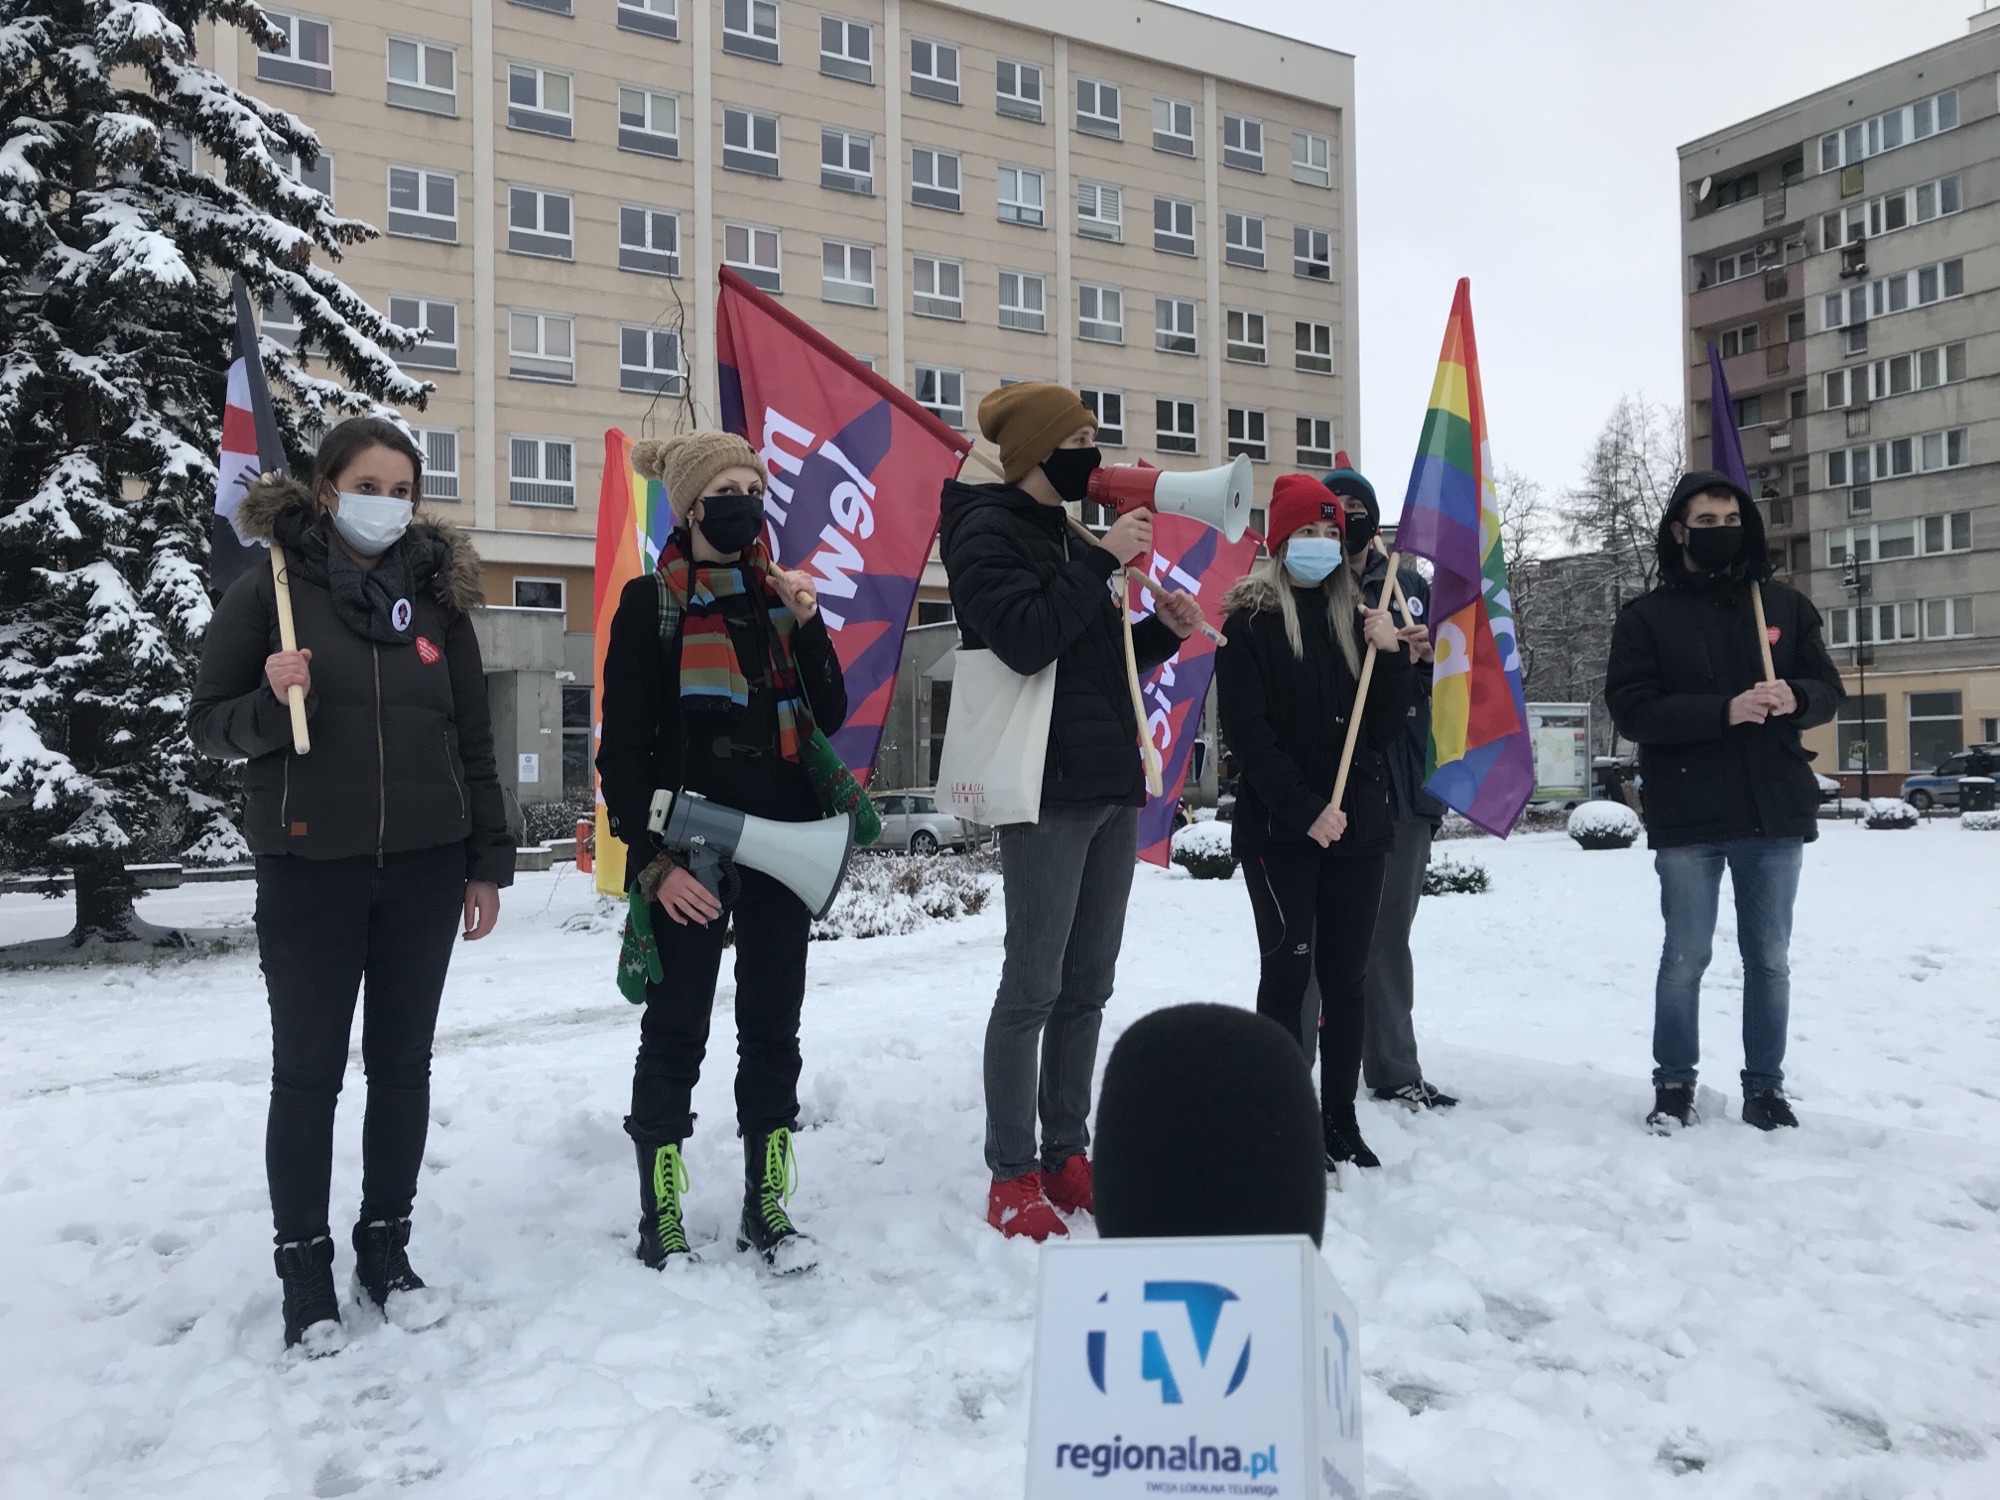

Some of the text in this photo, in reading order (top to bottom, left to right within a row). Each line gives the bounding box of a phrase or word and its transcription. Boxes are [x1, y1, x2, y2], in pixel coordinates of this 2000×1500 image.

[1056, 1435, 1279, 1479] regionalna.pl
[1146, 1482, 1279, 1498] TWOJA LOKALNA TELEWIZJA
